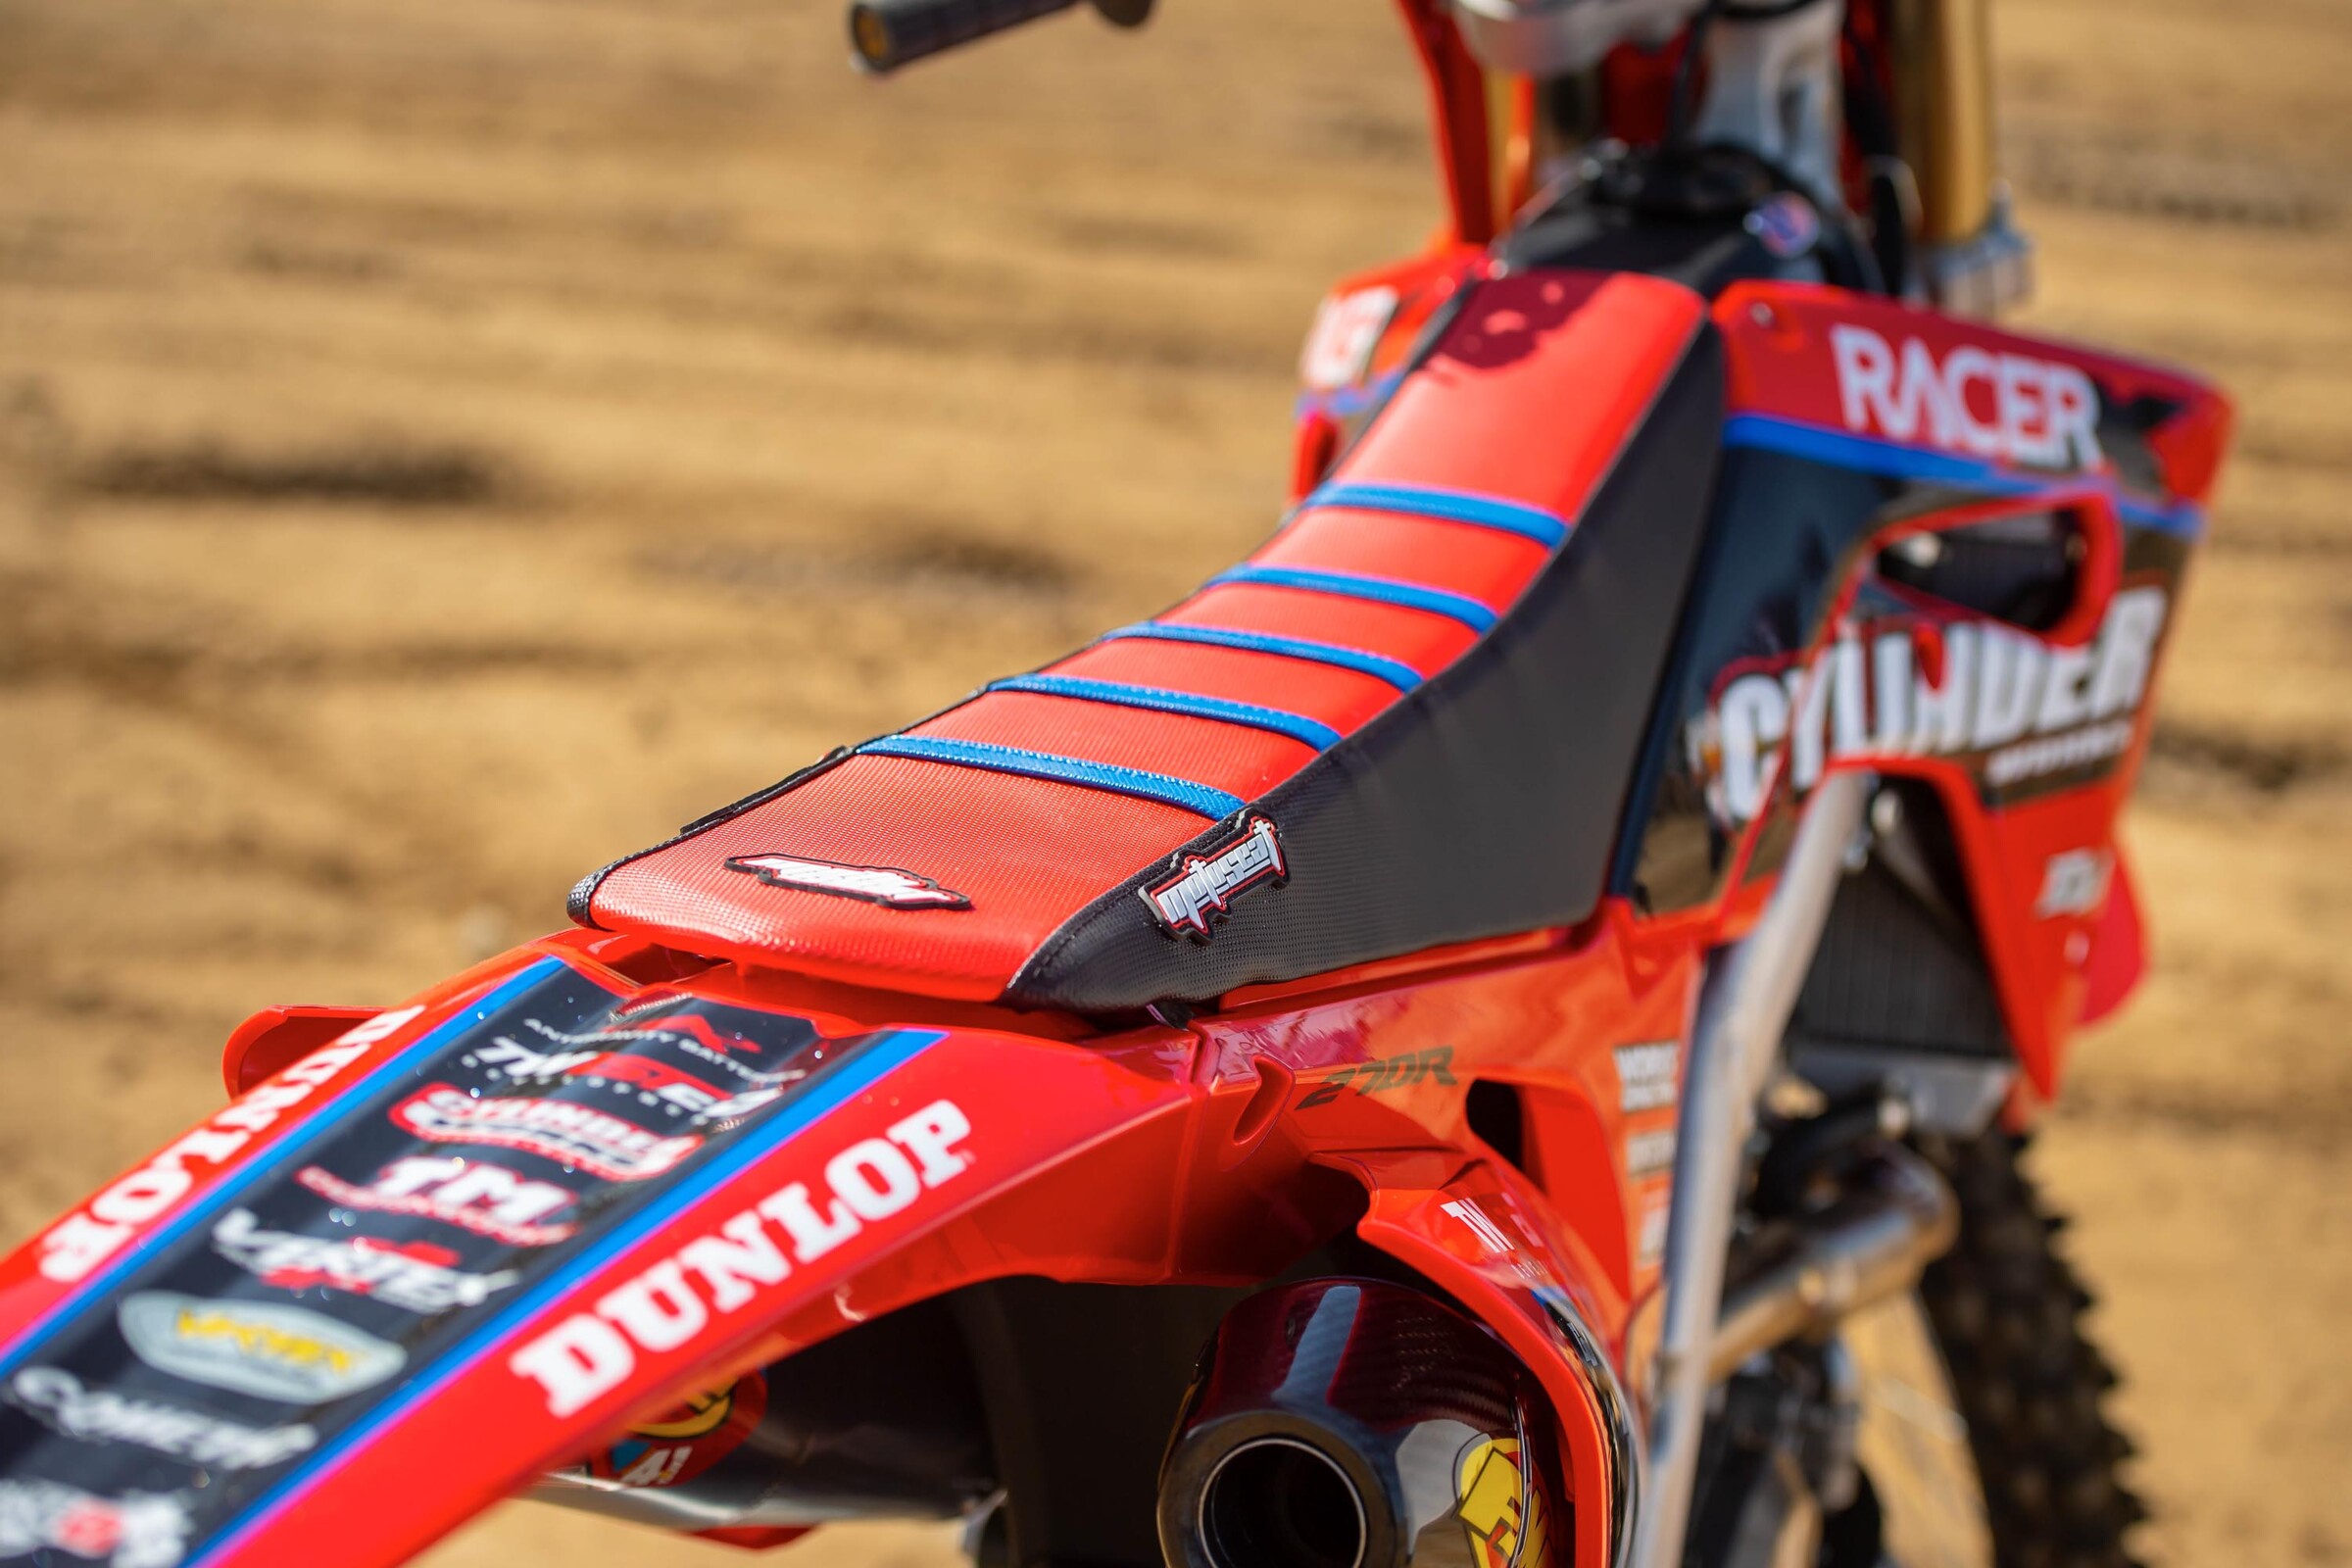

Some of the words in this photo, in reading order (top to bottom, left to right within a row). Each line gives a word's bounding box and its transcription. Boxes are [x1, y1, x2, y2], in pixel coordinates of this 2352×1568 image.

[1832, 323, 2105, 470] RACER
[39, 1004, 426, 1282] DUNLOP
[510, 1100, 971, 1418] DUNLOP
